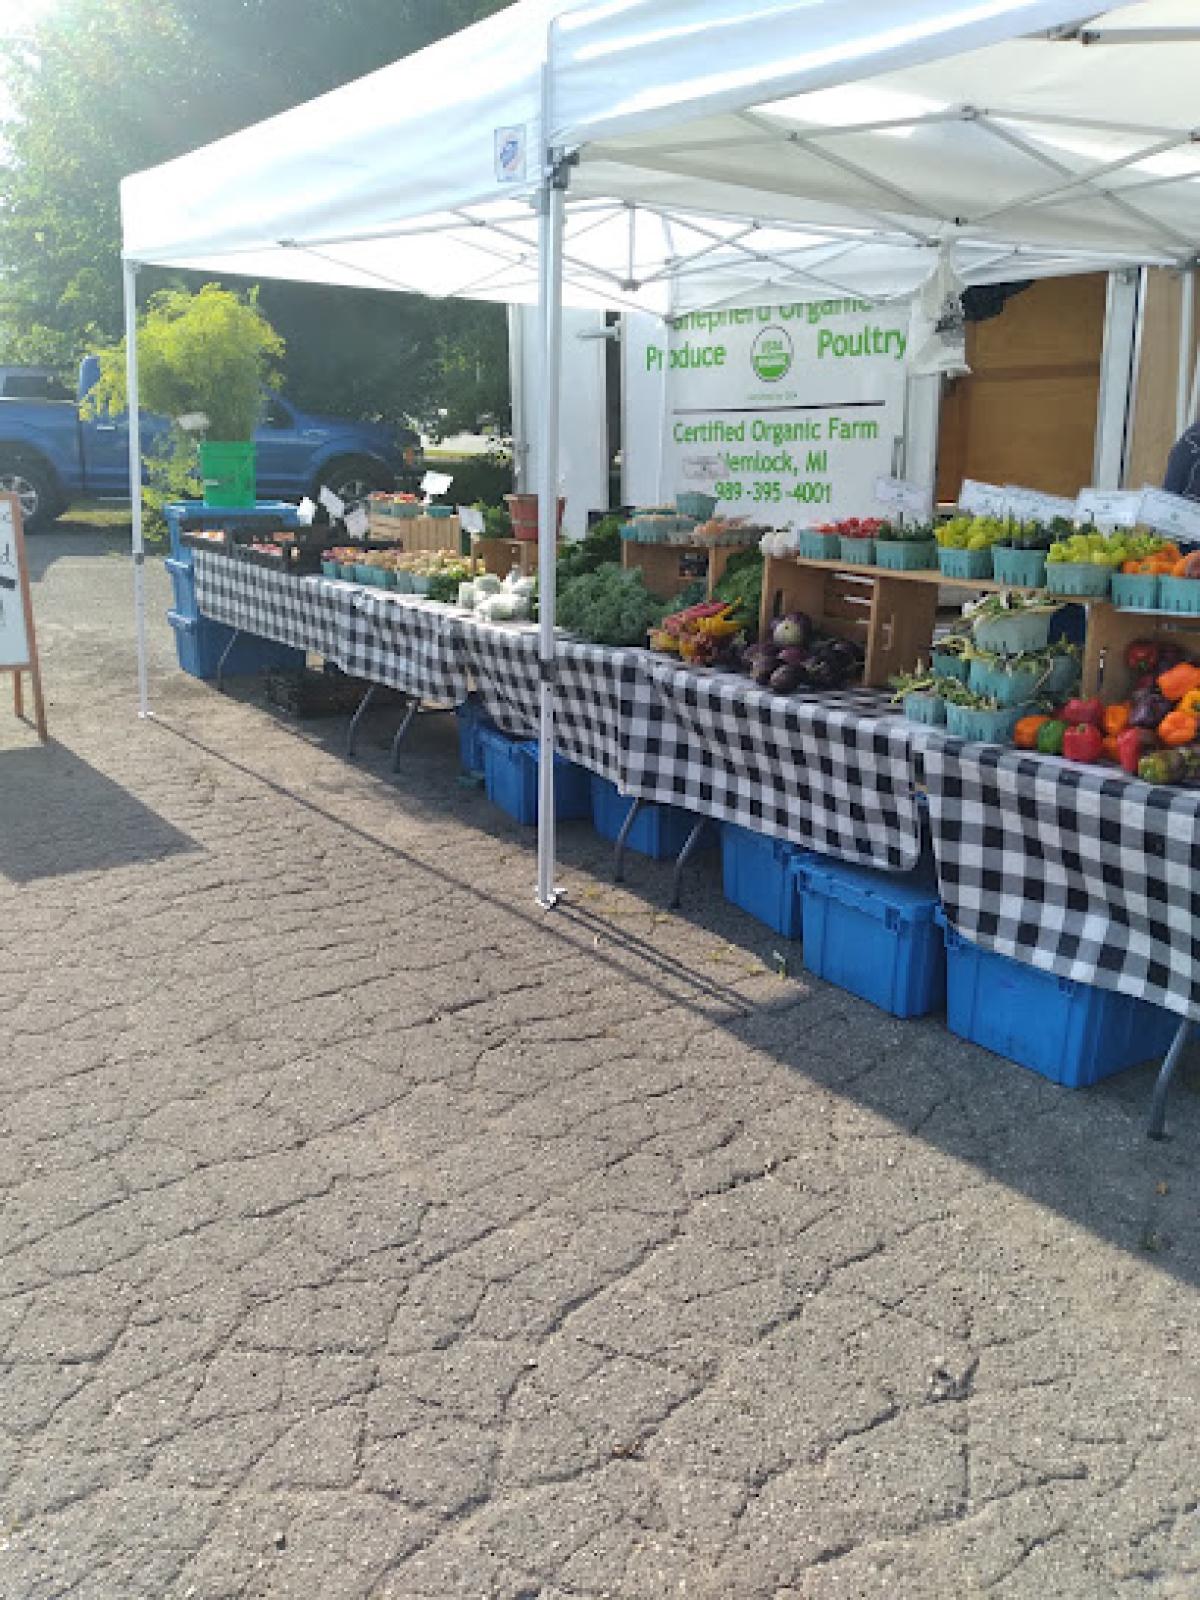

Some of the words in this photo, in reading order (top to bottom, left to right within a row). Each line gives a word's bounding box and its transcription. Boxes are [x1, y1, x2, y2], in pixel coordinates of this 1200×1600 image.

[817, 324, 907, 360] Poultry
[673, 420, 745, 443] Certified
[752, 418, 821, 447] Organic
[828, 417, 878, 440] Farm
[717, 450, 798, 477] emlock,
[805, 450, 828, 473] MI
